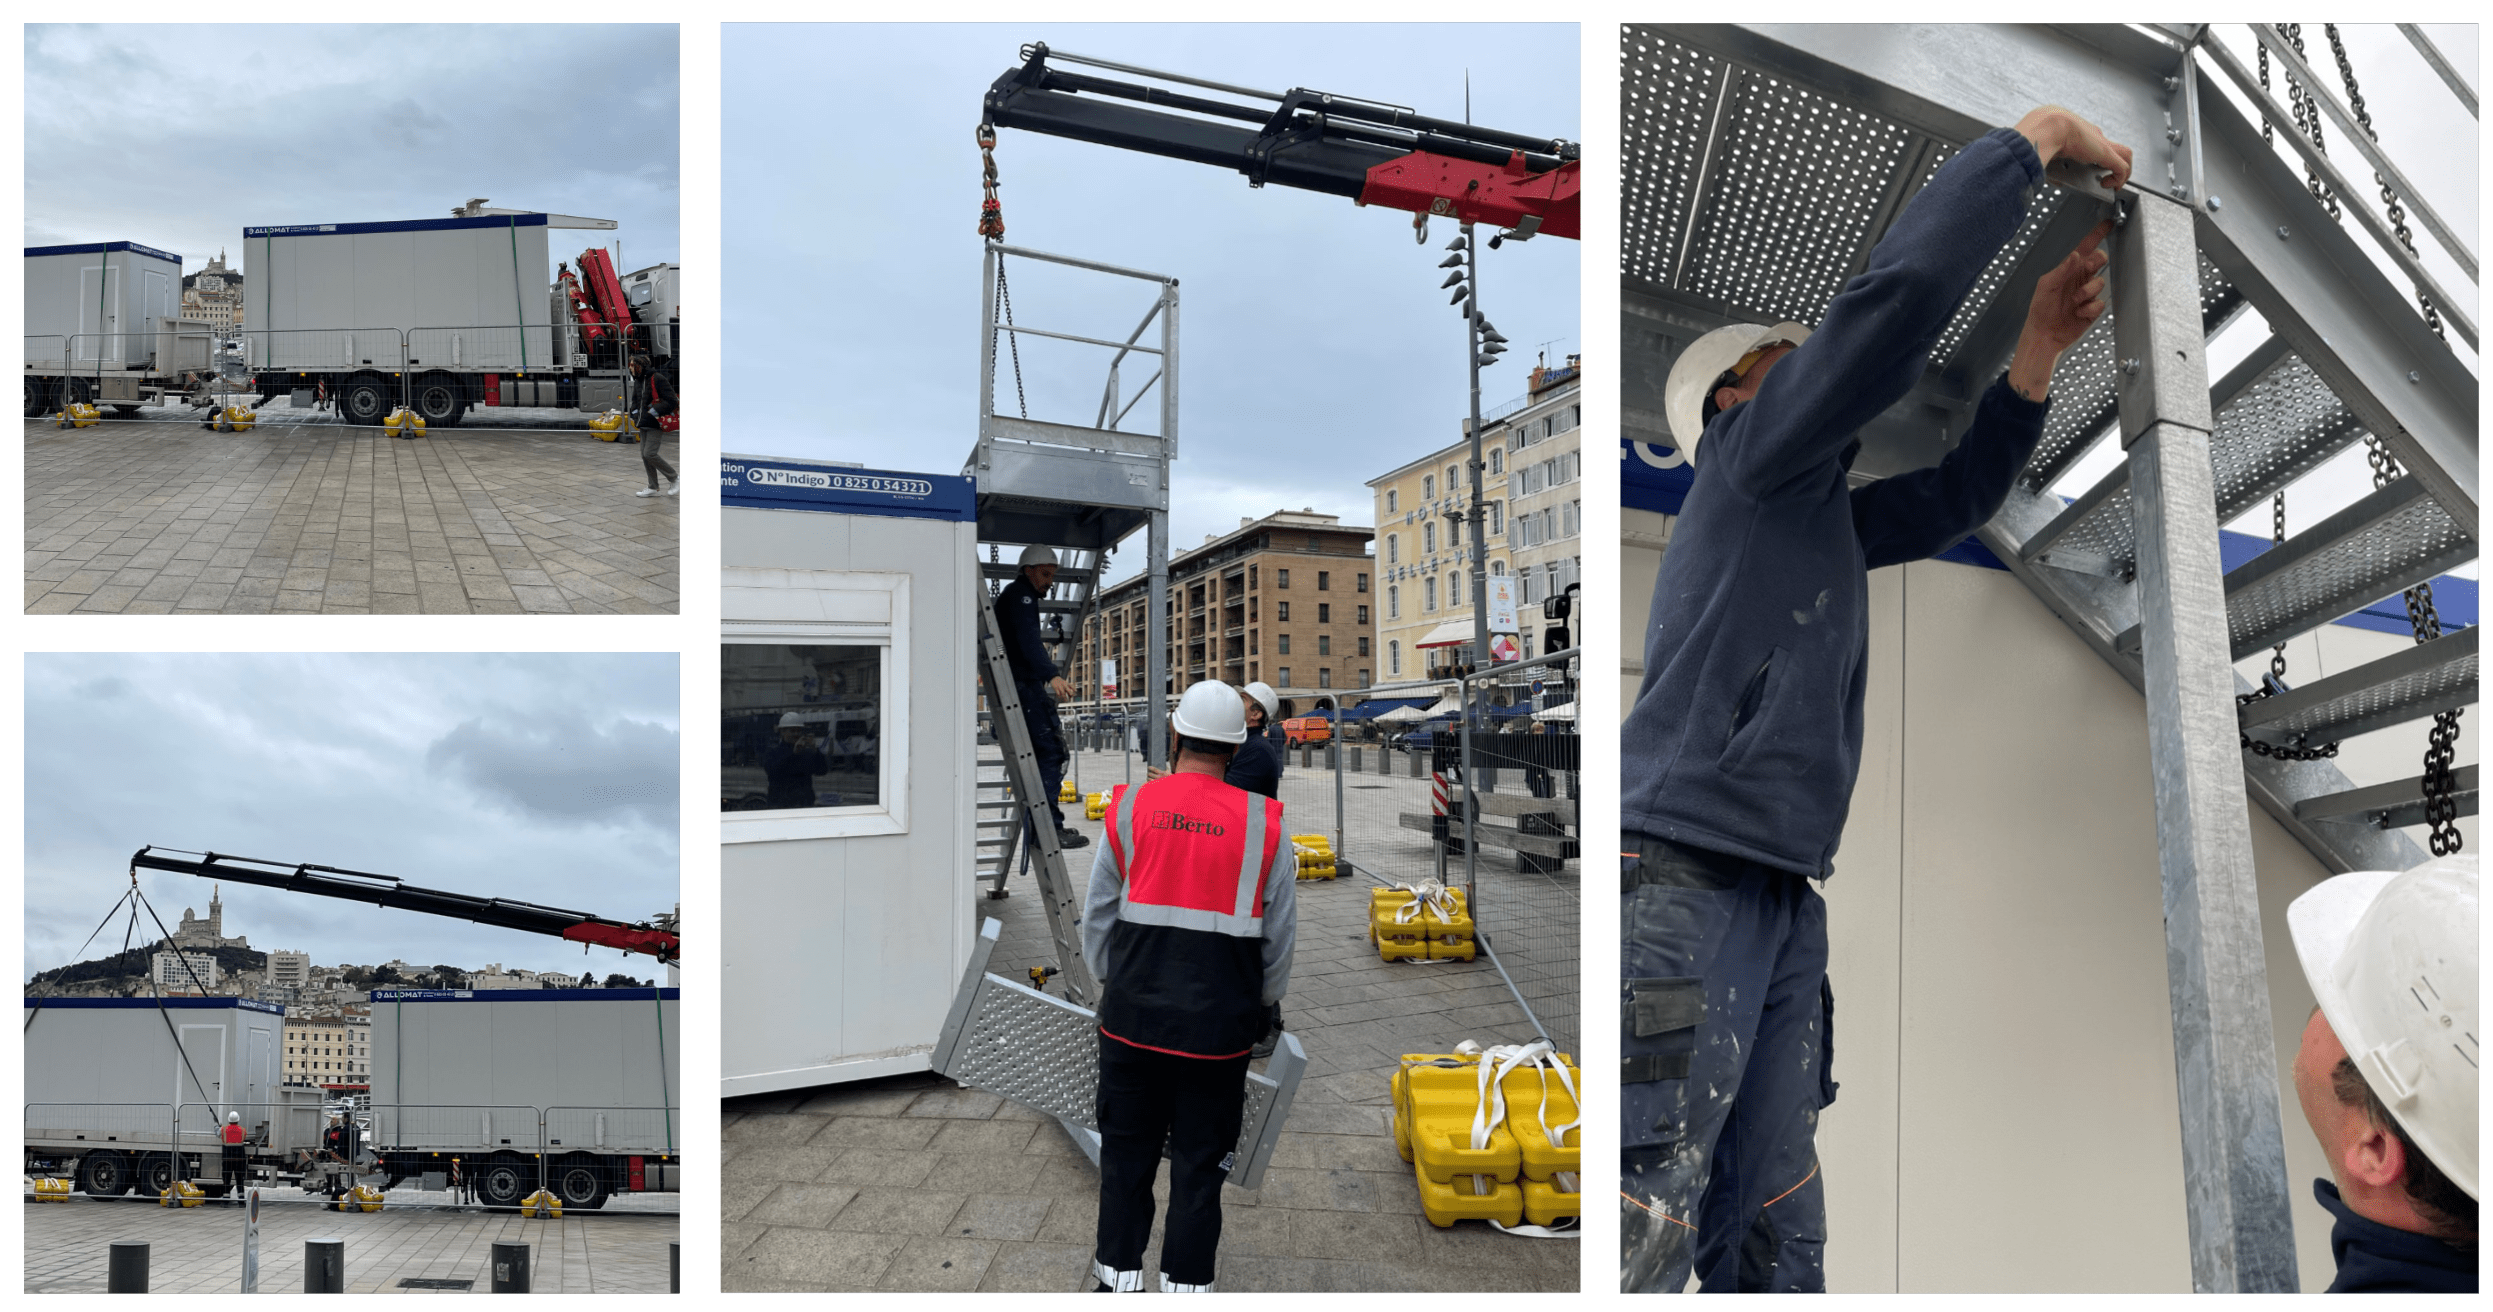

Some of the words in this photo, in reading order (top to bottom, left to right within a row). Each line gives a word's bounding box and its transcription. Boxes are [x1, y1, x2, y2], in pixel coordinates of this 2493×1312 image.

[254, 226, 291, 234] ALLOMAT
[767, 471, 784, 482] N°
[785, 472, 825, 487] Indigo
[833, 476, 842, 487] 0
[845, 477, 869, 489] 825
[872, 479, 881, 490] 0
[883, 480, 926, 493] 54321
[1406, 493, 1465, 526] HOTEL
[1172, 813, 1225, 837] Berto
[383, 991, 423, 999] ALLOMAT
